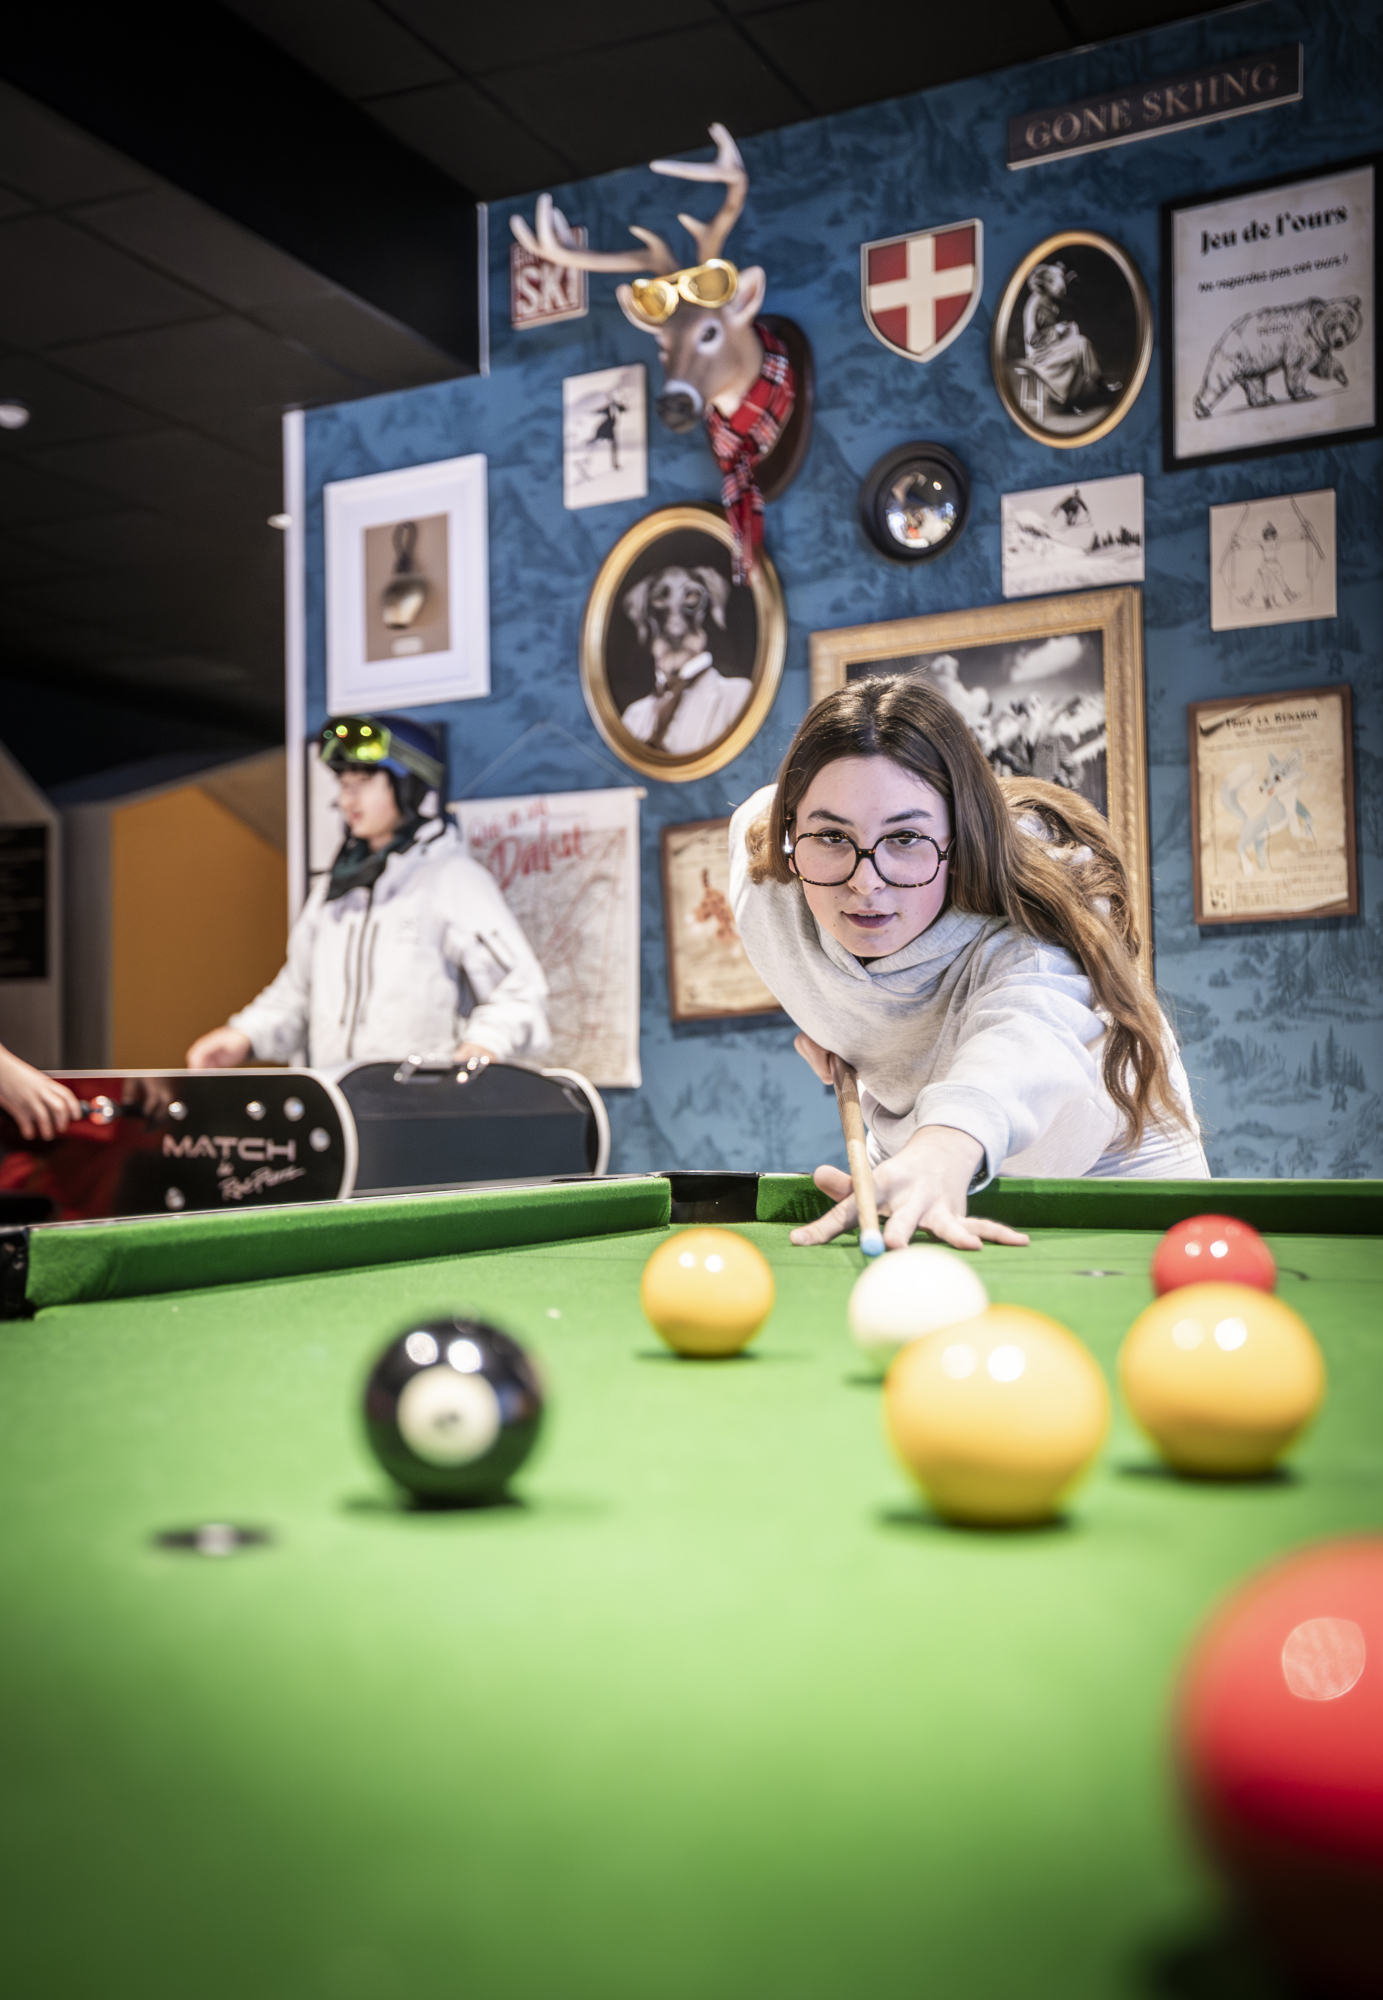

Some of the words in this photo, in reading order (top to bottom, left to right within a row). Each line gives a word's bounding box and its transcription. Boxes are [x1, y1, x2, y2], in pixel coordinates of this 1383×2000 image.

[1025, 99, 1132, 149] GONE
[1143, 62, 1278, 122] SKIING
[1200, 230, 1238, 256] Jeu
[1242, 218, 1272, 243] de
[1276, 205, 1348, 237] l'ours
[519, 264, 580, 314] SKI
[162, 1134, 297, 1162] MATCH
